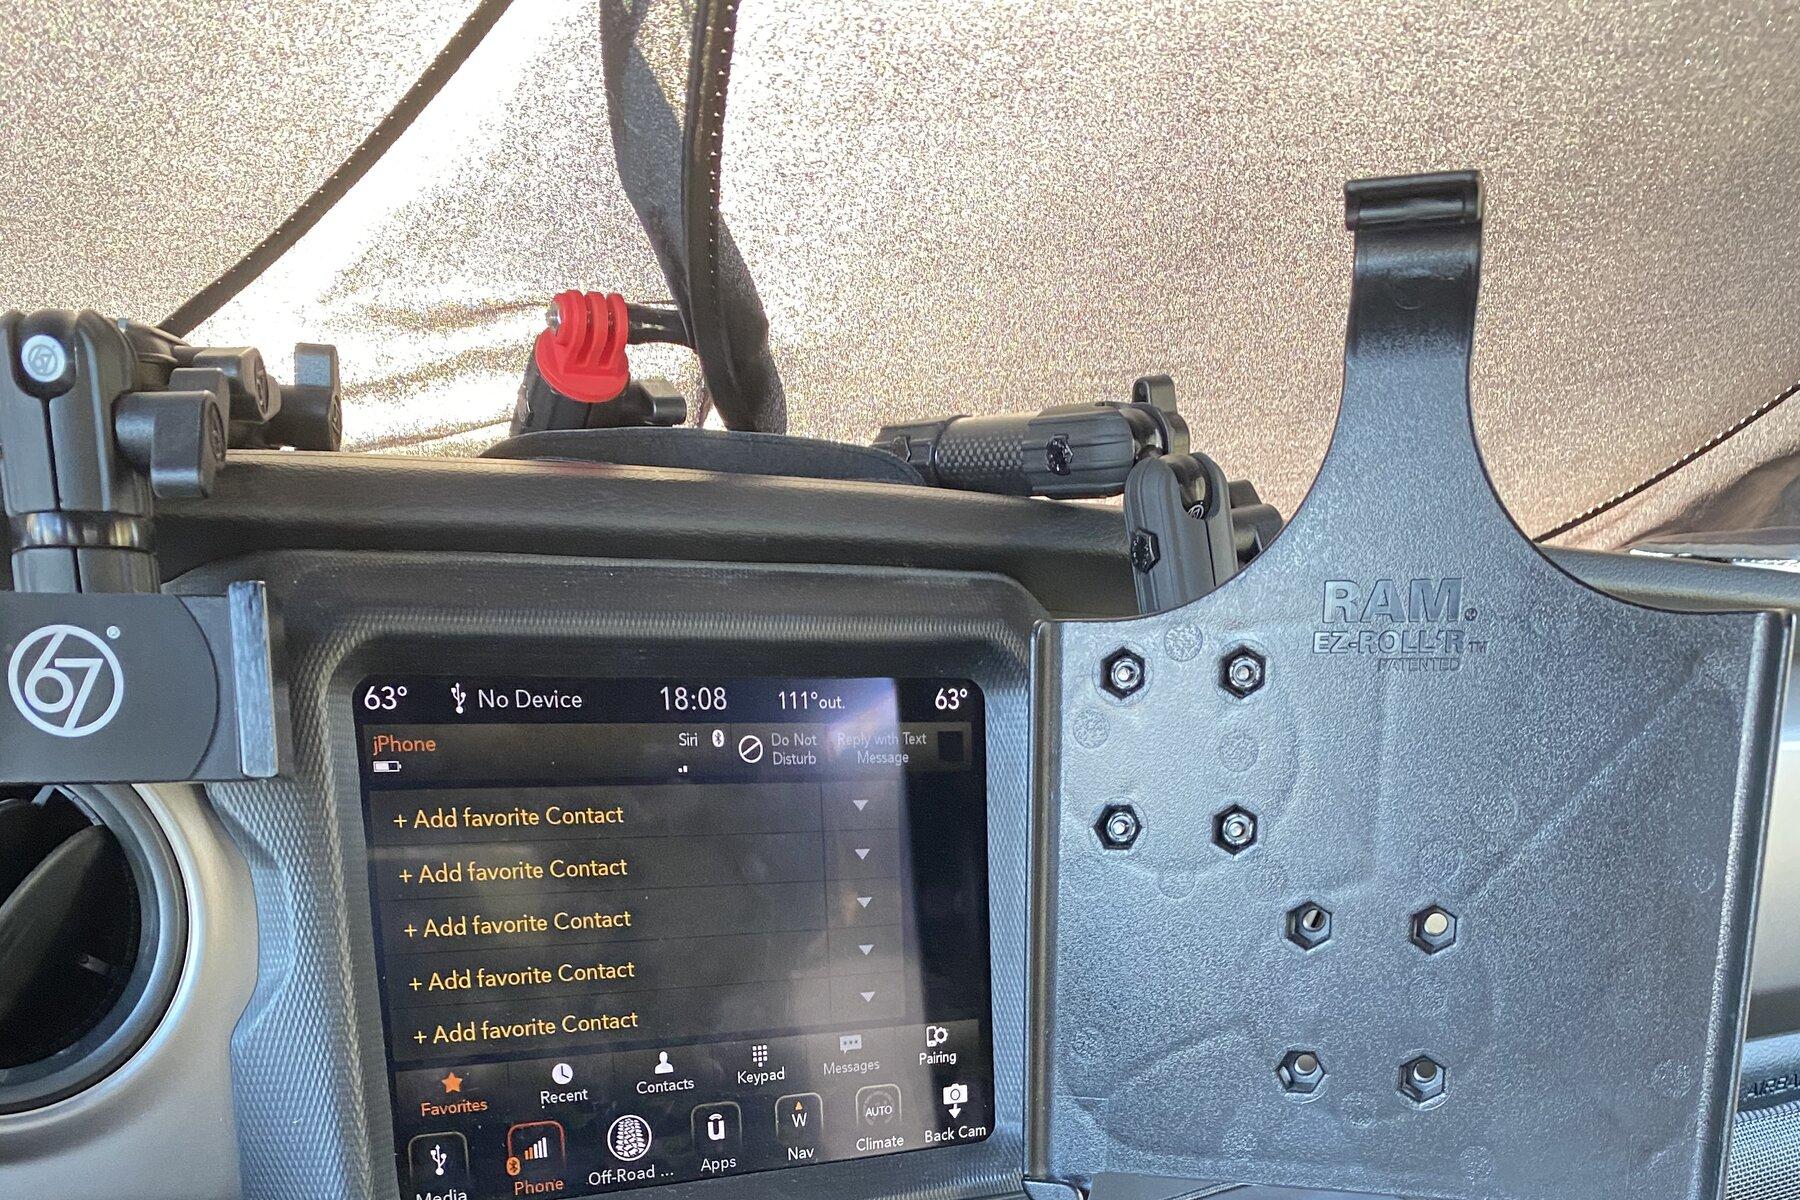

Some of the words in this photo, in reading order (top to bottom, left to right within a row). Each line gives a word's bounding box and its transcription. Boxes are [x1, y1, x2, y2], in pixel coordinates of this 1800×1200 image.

[1377, 658, 1461, 672] PATENTED
[20, 630, 108, 732] 67
[364, 686, 408, 710] 63°
[478, 690, 508, 708] No
[516, 689, 583, 709] Device
[660, 687, 727, 711] 18:08
[934, 688, 968, 710] 63°
[678, 732, 698, 747] Siri
[771, 732, 791, 747] Do
[794, 732, 817, 747] Not
[837, 732, 870, 748] Reply
[873, 732, 899, 746] with
[902, 731, 927, 745] Text
[772, 752, 817, 766] Disturb
[857, 752, 909, 767] Message
[414, 808, 457, 829] Add
[463, 807, 539, 827] favorite
[545, 806, 624, 825] Contact
[419, 862, 462, 883] Add
[467, 861, 544, 881] favorite
[550, 859, 628, 878] Contact
[424, 916, 467, 938] Add
[472, 914, 548, 935] favorite
[554, 910, 632, 930] Contact
[428, 969, 471, 991] Add
[476, 967, 552, 988] favorite
[557, 961, 635, 982] Contact
[432, 1021, 476, 1044] Add
[481, 1018, 556, 1040] favorite
[561, 1011, 639, 1033] Contact
[919, 1051, 957, 1066] Pairing
[737, 1067, 785, 1085] Keypad
[823, 1059, 880, 1077] Messages
[636, 1077, 695, 1095] Contacts
[540, 1088, 588, 1105] Recent
[421, 1099, 488, 1117] Favorites
[865, 1105, 893, 1117] AUTO
[791, 1113, 807, 1127] W
[924, 1127, 954, 1143] Back
[958, 1125, 987, 1139] Cam
[856, 1136, 904, 1152] Climate
[787, 1147, 815, 1161] Nav
[700, 1158, 737, 1173] Apps
[588, 1165, 655, 1187] Off-Road
[514, 1178, 564, 1196] Phone
